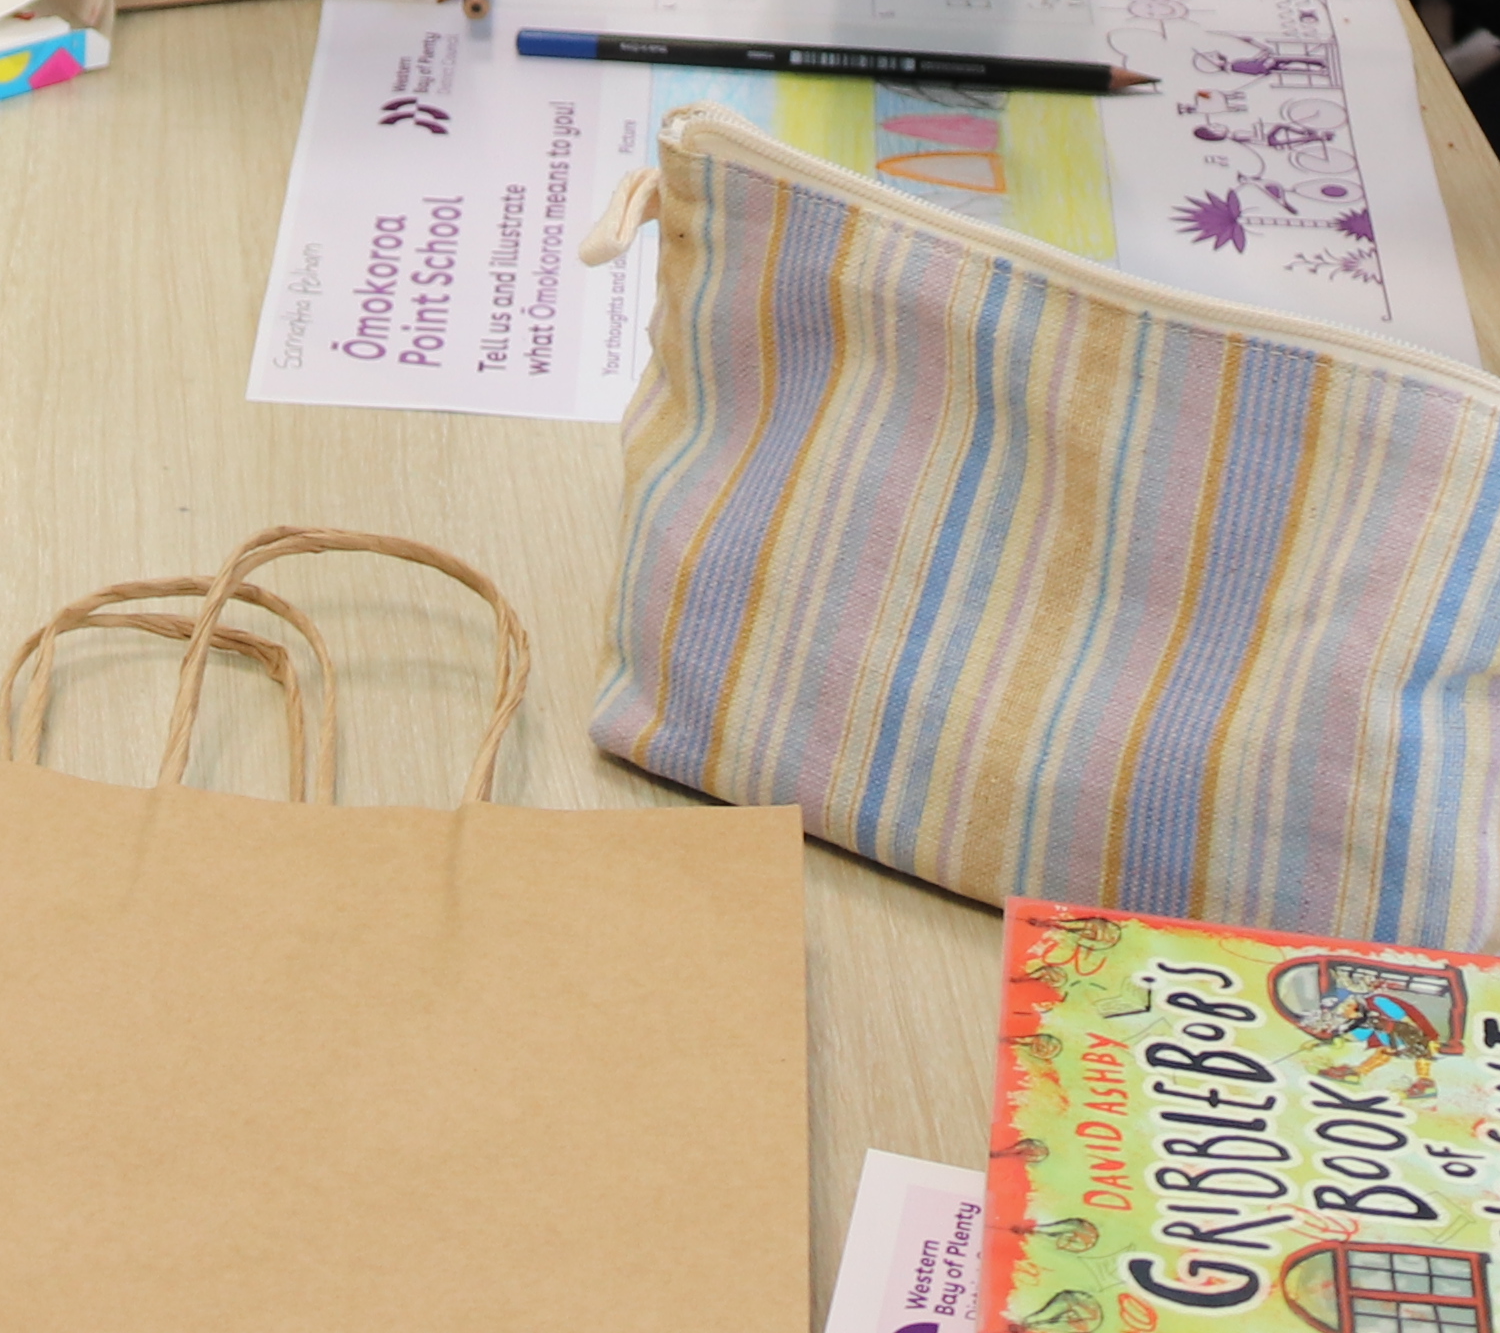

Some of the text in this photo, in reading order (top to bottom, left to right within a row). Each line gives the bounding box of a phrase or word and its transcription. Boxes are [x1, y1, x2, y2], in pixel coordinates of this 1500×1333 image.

[520, 100, 582, 376] what Ōmokoroa means to you!
[330, 215, 407, 363] Ōmokoroa
[398, 194, 465, 369] Point School
[476, 183, 527, 374] Tell us and illustrate
[608, 271, 629, 295] and
[602, 296, 629, 350] thoughts
[600, 350, 625, 377] Your
[1075, 1031, 1133, 1212] DAVID ASHBY
[1304, 1081, 1439, 1222] BOOK
[946, 1201, 982, 1257] Plenty
[905, 1239, 940, 1310] Western
[934, 1282, 966, 1317] Bay
[941, 1258, 962, 1279] of
